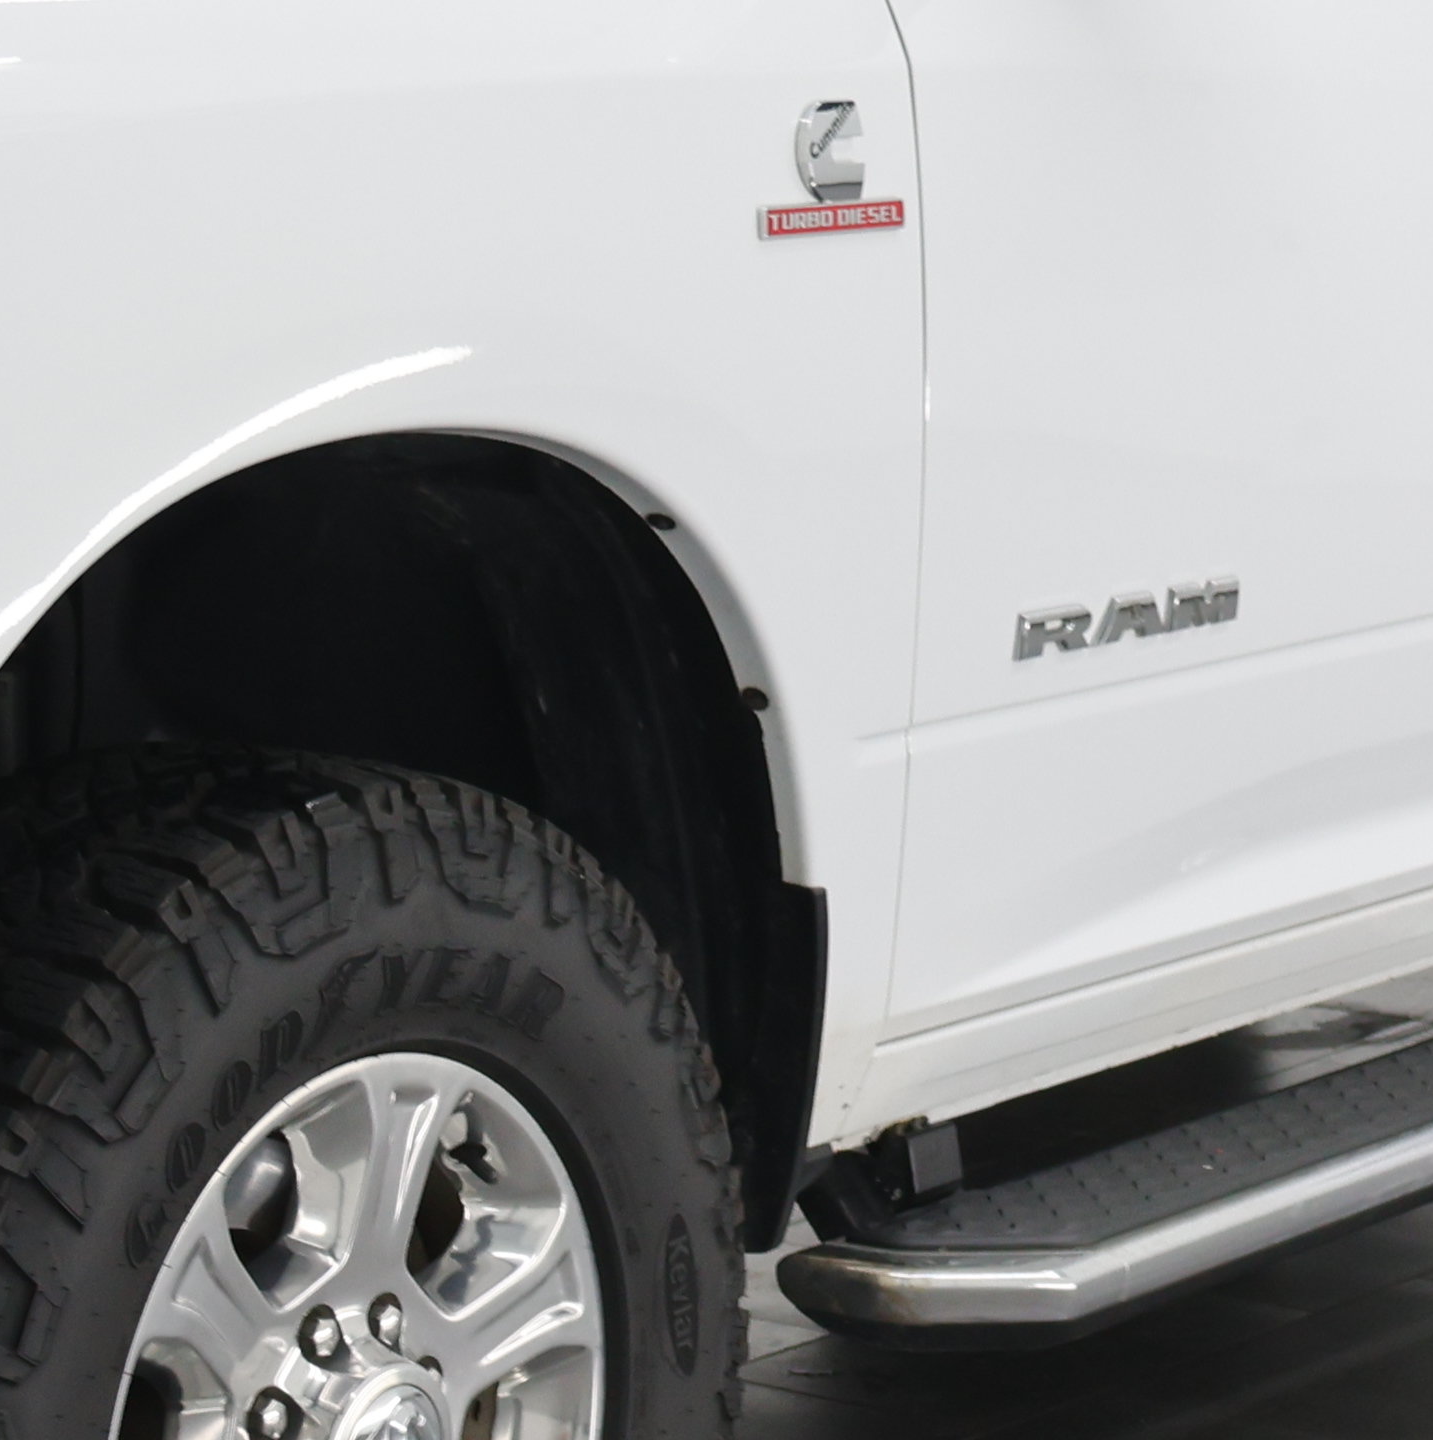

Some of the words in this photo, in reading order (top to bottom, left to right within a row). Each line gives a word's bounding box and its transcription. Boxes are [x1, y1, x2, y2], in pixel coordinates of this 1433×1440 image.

[768, 211, 833, 231] TURBO
[837, 205, 902, 227] DIESEL
[1012, 571, 1240, 662] RAM
[122, 943, 567, 1270] GOODYEAR
[667, 1235, 694, 1350] Kevlar
